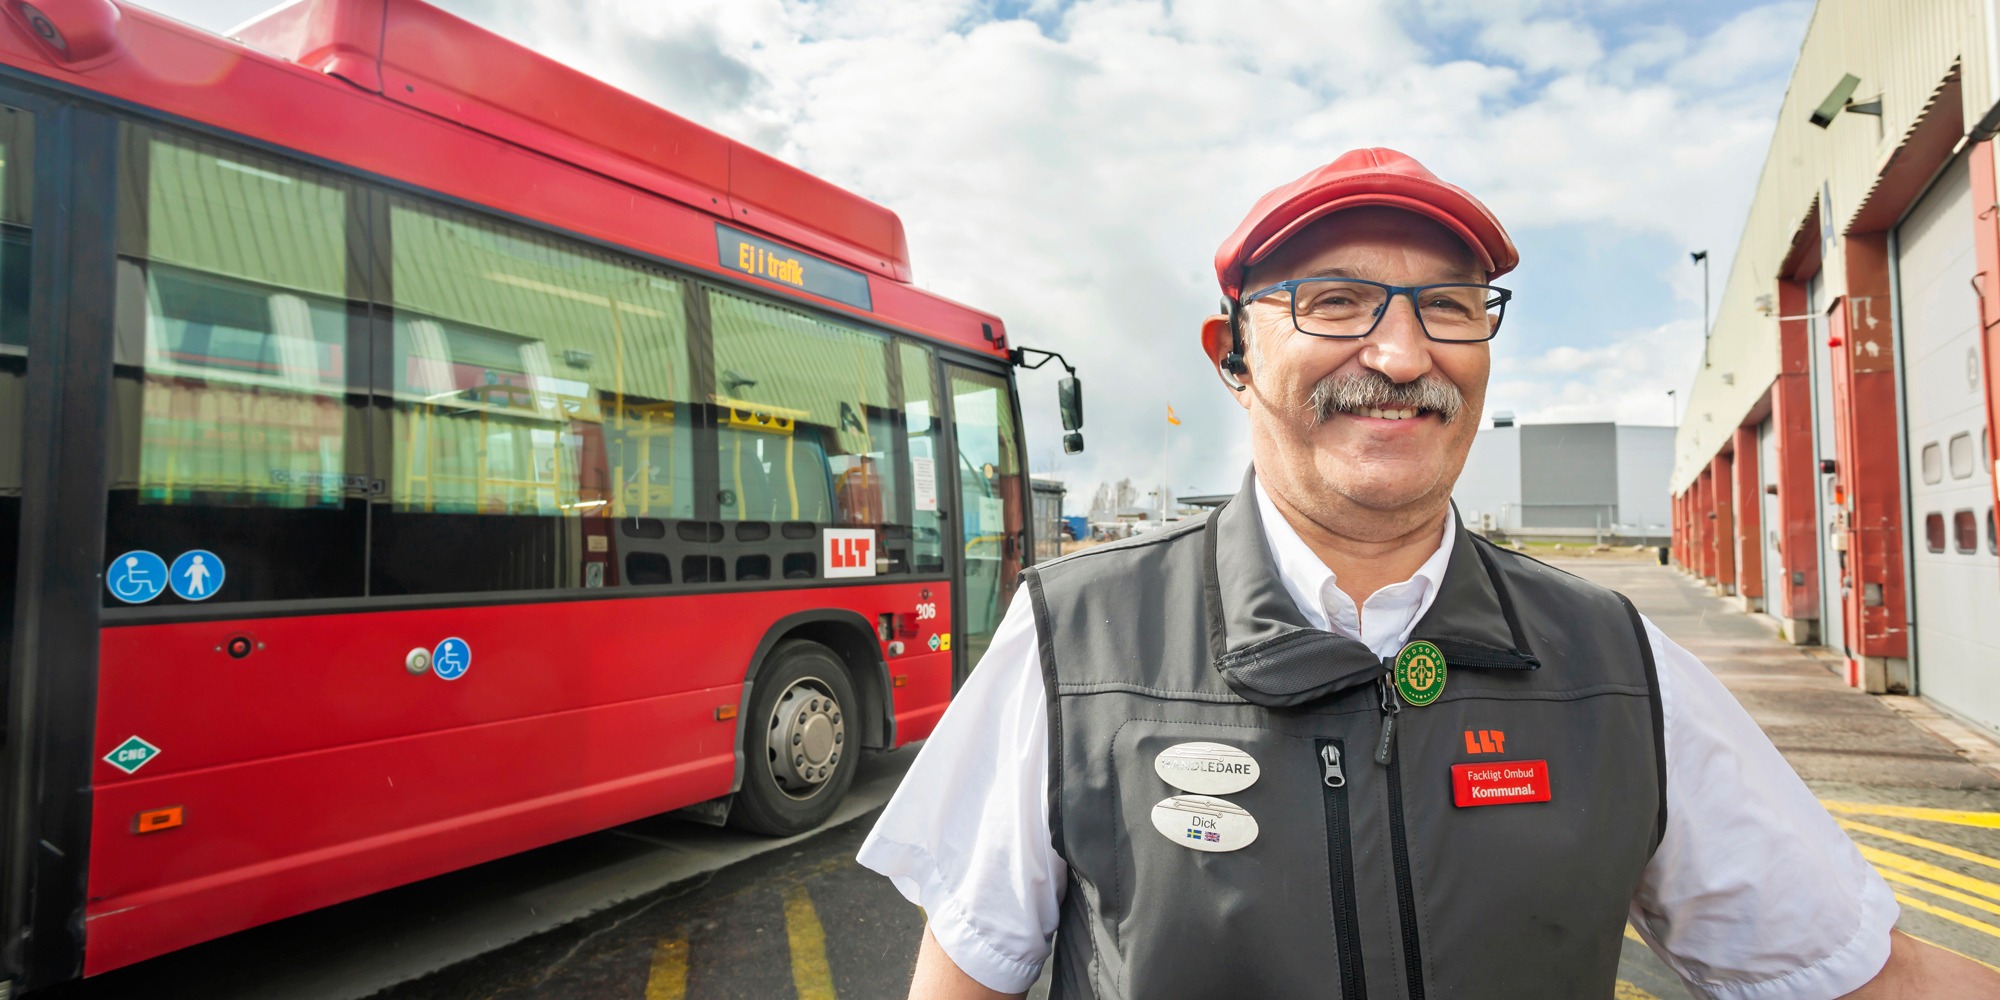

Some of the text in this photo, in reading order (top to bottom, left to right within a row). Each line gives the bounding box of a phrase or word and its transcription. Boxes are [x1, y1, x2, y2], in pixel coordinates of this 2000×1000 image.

[739, 242, 804, 286] Ej i trafik
[830, 538, 870, 568] LLT
[915, 603, 936, 620] 206
[1399, 646, 1443, 683] SKYDDSOMBUD
[1381, 720, 1393, 760] TEXSTAR
[1464, 729, 1505, 754] LLT
[117, 747, 147, 762] CNG
[1467, 768, 1534, 782] Fackligt Ombud
[1192, 815, 1217, 829] Dick
